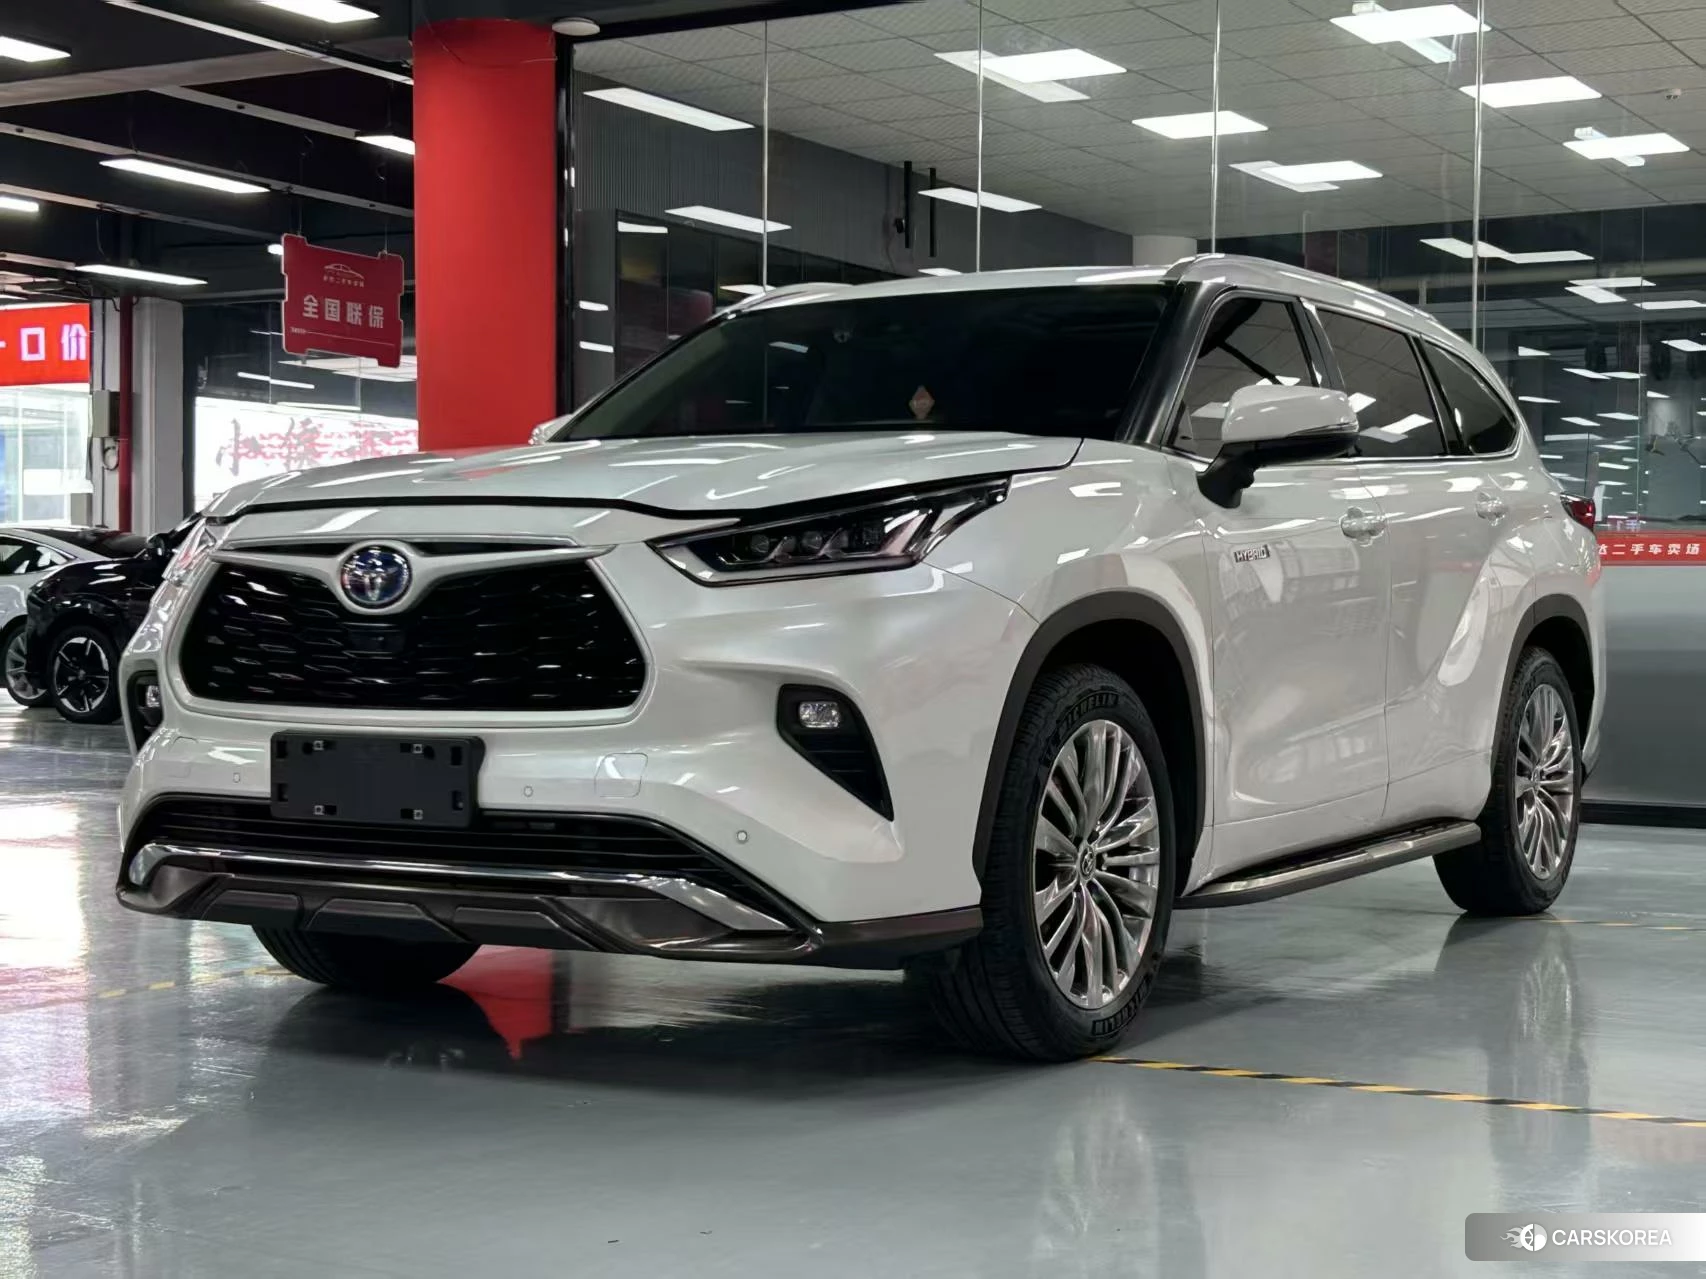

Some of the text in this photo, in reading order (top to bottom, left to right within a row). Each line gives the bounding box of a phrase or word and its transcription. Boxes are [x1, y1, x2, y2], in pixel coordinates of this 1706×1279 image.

[303, 295, 384, 328] 全国联保
[0, 324, 87, 361] 口价
[1235, 545, 1269, 562] HYBRID
